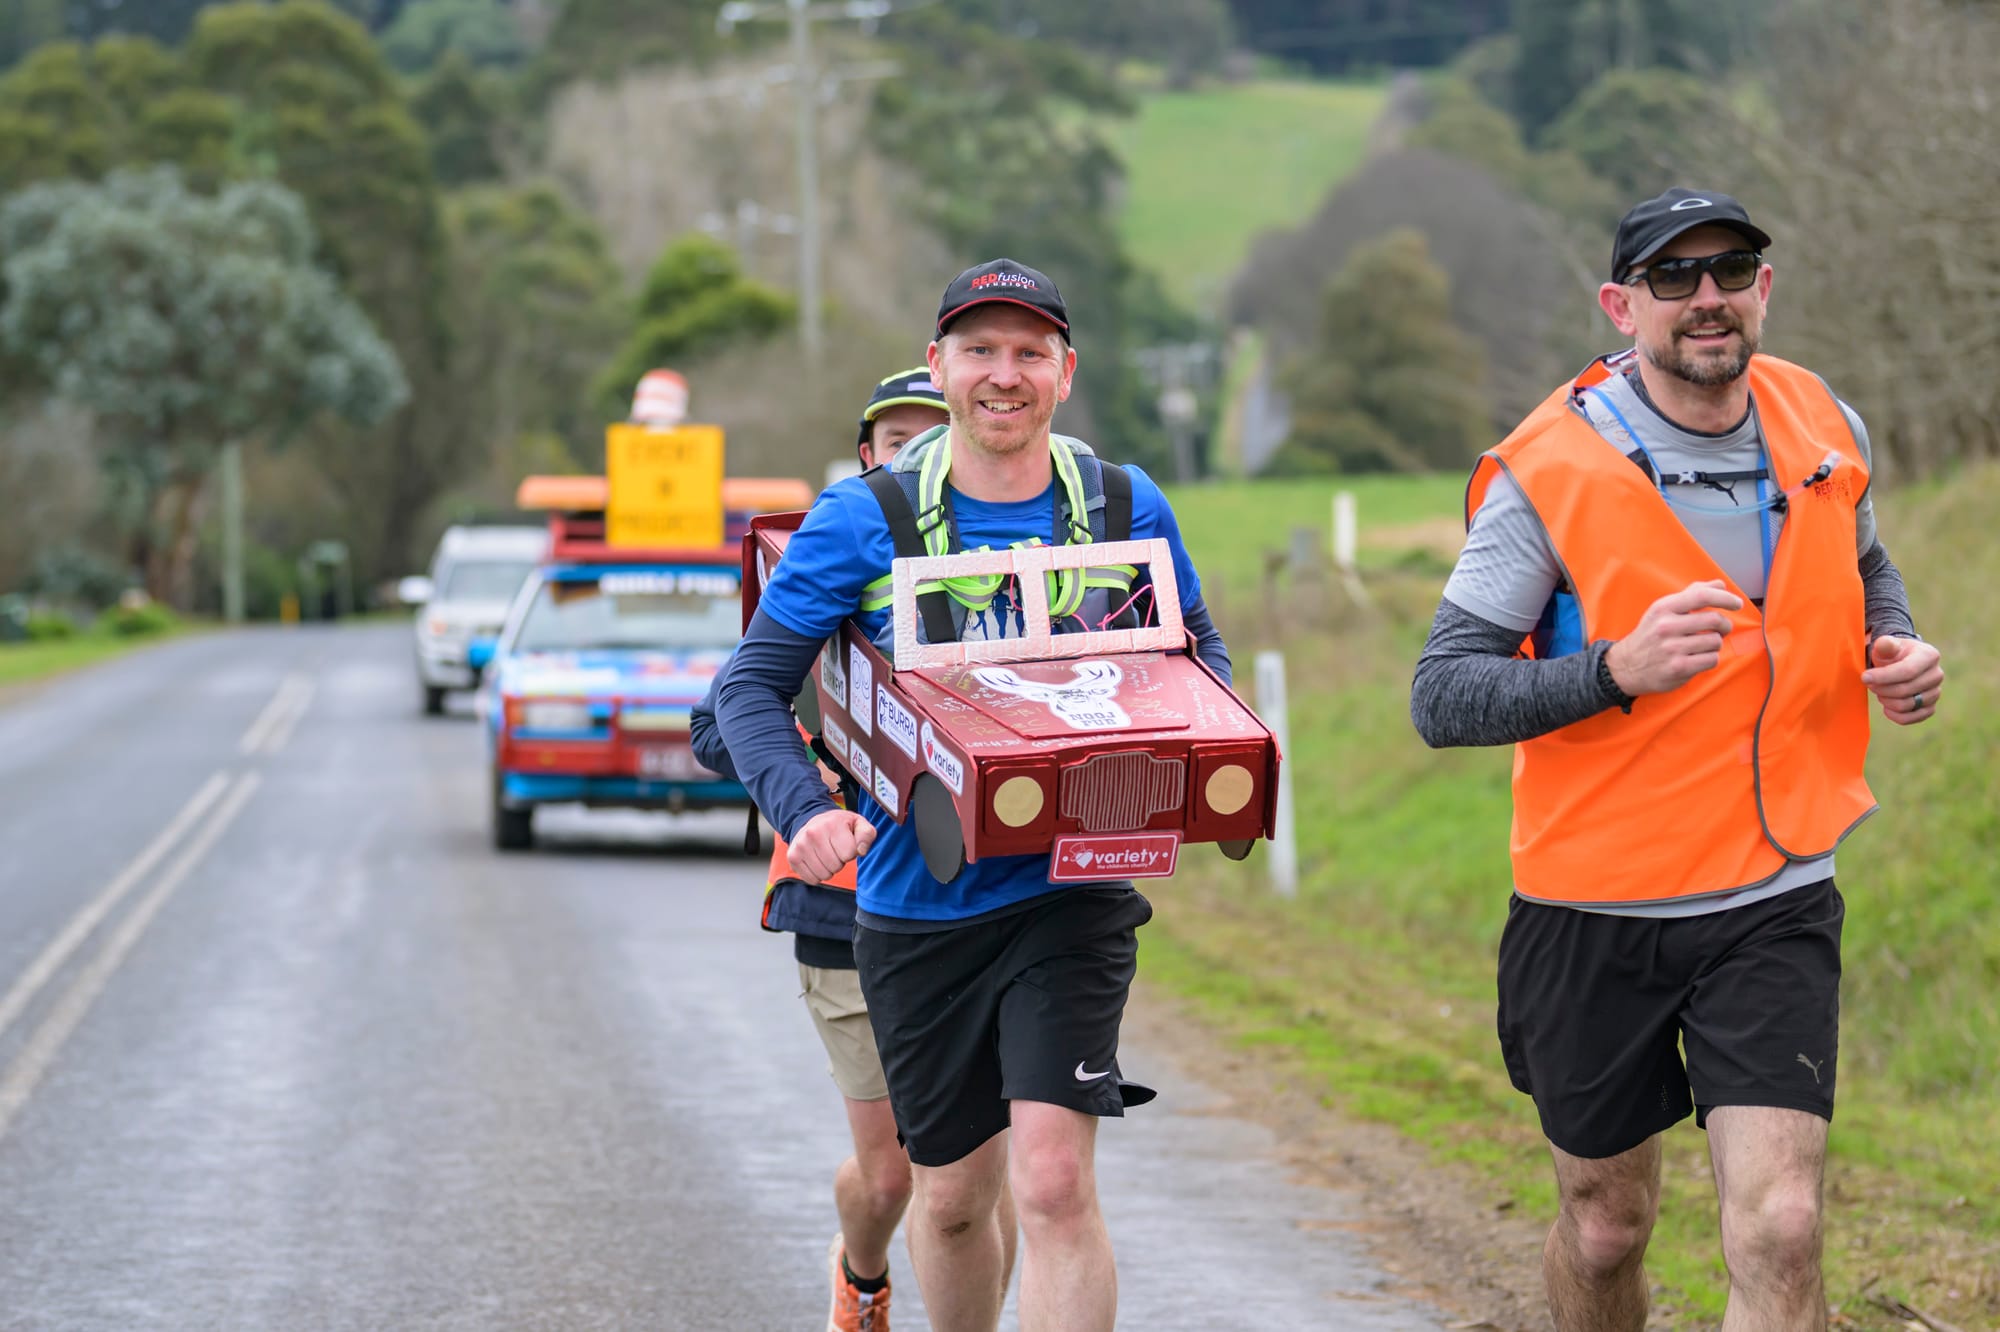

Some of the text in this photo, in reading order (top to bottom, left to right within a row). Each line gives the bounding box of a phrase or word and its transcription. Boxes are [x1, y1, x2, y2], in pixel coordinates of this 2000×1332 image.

[972, 272, 1035, 288] REDfusion
[888, 705, 915, 737] BURRA
[1069, 711, 1116, 720] NOOJ
[933, 749, 961, 786] variety
[1095, 849, 1158, 865] variety
